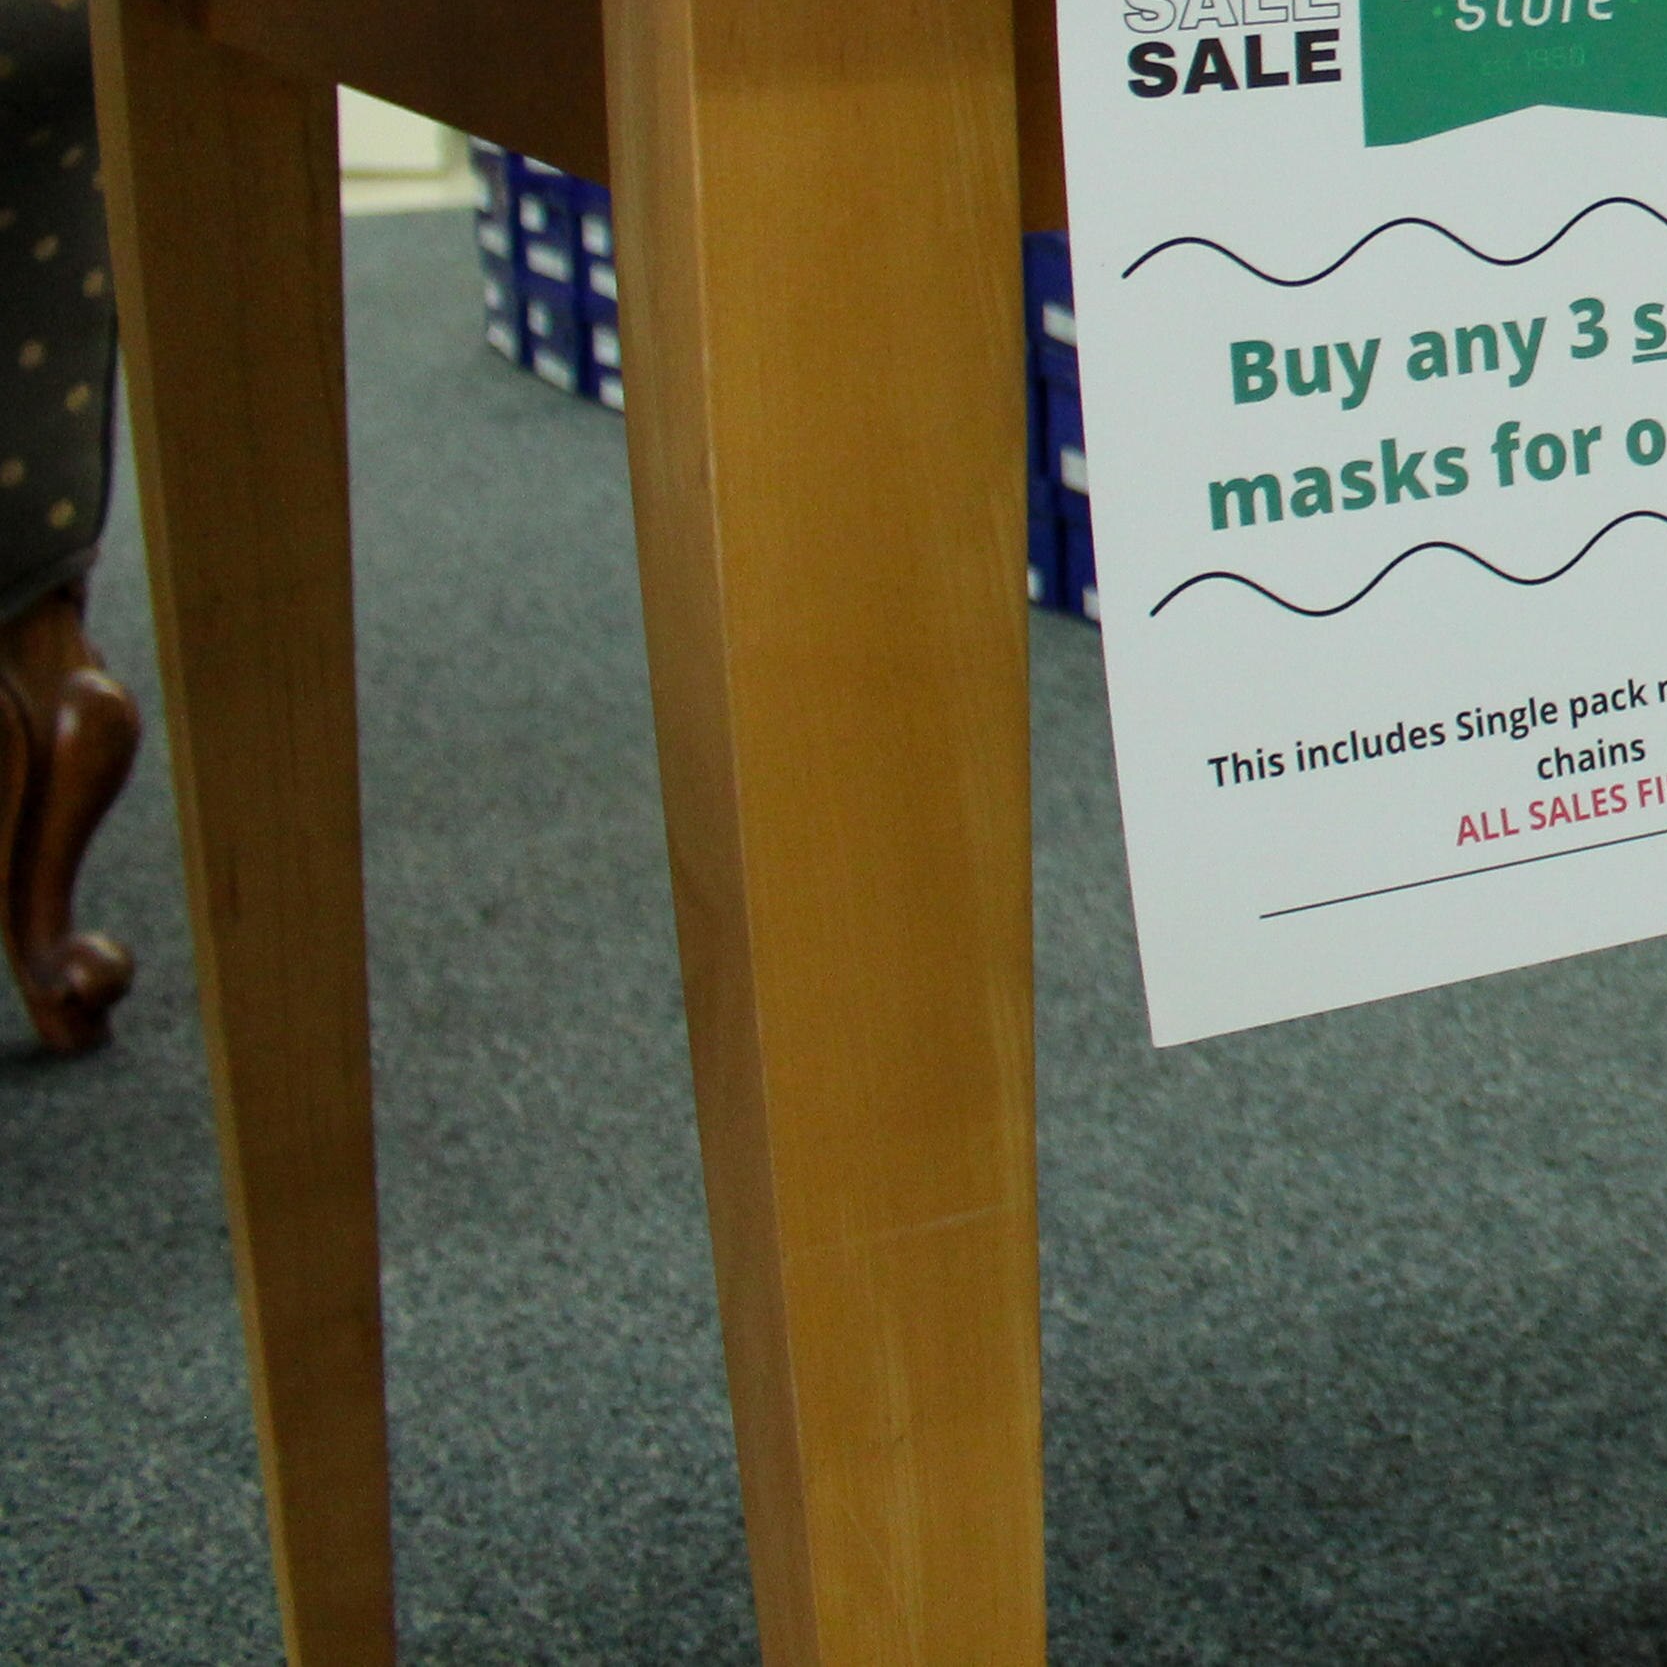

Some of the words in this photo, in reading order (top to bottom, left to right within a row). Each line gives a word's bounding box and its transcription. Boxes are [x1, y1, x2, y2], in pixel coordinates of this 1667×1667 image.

[1127, 28, 1342, 96] SALE
[1229, 339, 1381, 411] Buy
[1406, 317, 1548, 387] any
[1569, 296, 1608, 359] 3
[1207, 439, 1470, 531] masks
[1491, 420, 1601, 487] for
[1208, 747, 1285, 789] This
[1296, 720, 1446, 770] includes
[1455, 698, 1559, 743] Single
[1569, 680, 1648, 727] pack
[1536, 736, 1647, 782] chains
[1456, 808, 1519, 847] ALL
[1529, 785, 1628, 831] SALES
